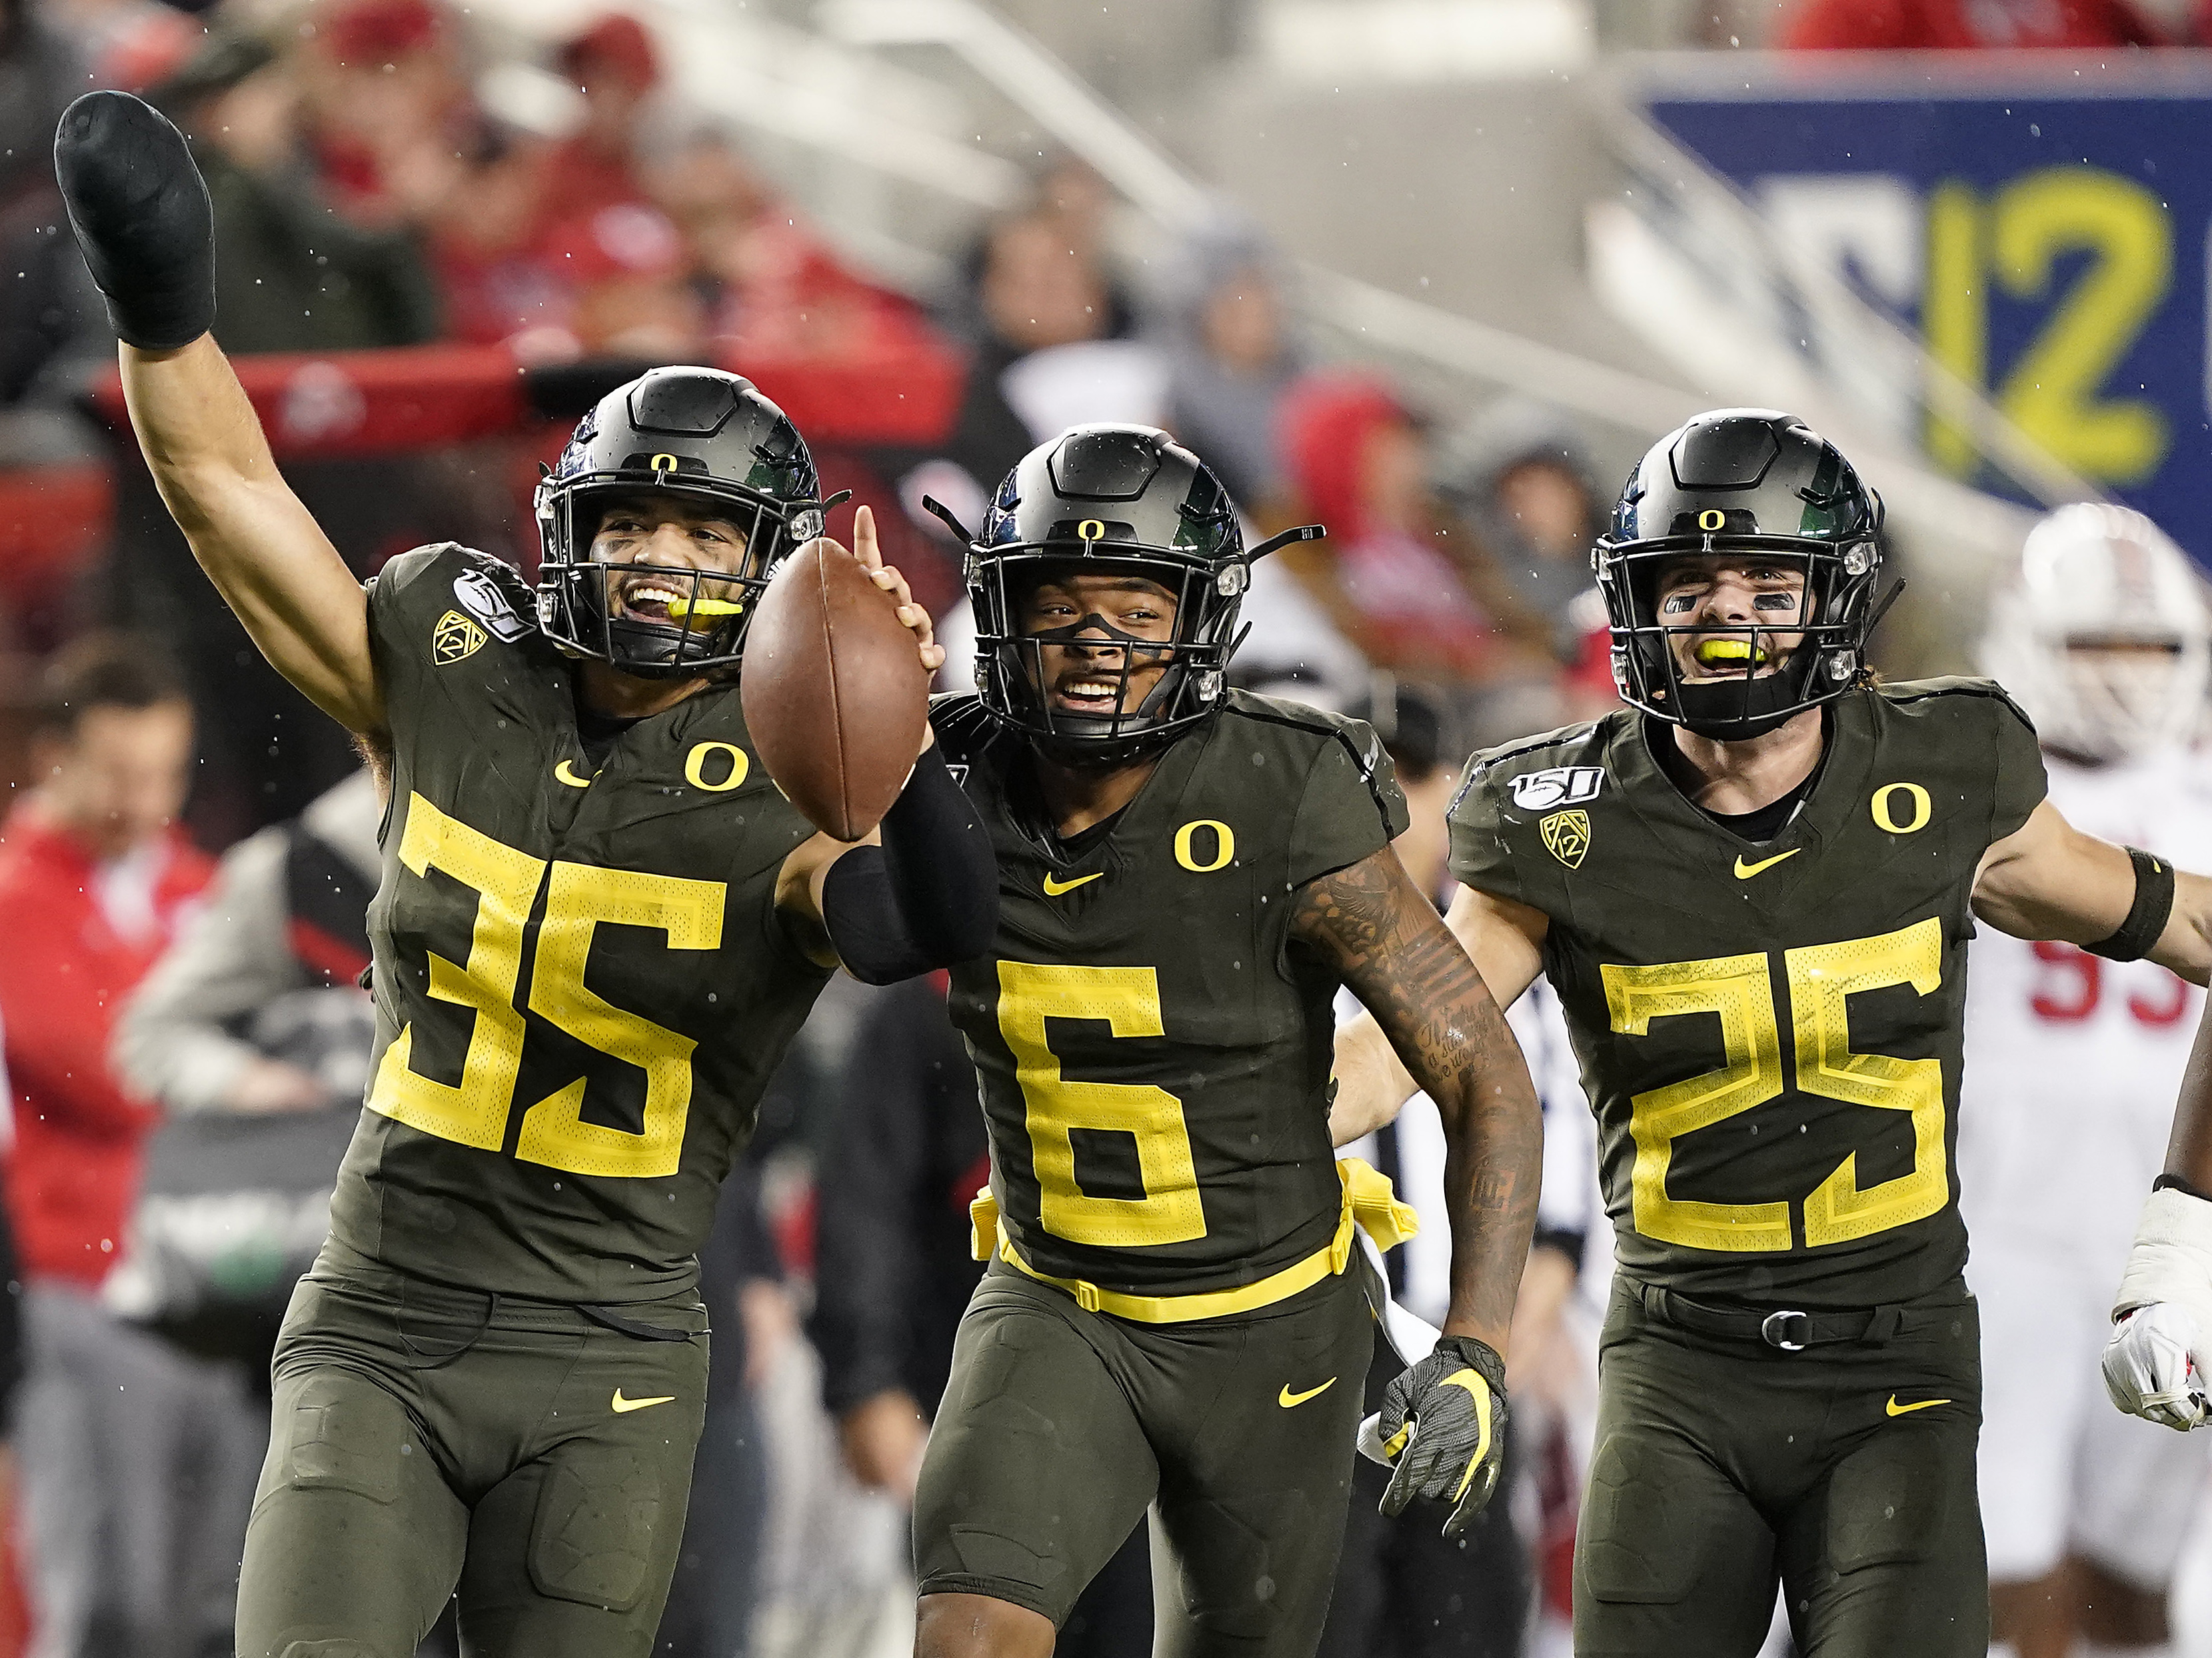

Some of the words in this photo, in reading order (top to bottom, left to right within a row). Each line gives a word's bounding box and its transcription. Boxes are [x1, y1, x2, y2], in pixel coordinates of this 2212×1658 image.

[1078, 519, 1105, 541] O
[1699, 509, 1725, 531] O
[437, 611, 486, 654] PAC
[437, 633, 465, 659] 12
[684, 741, 750, 791] O
[1507, 766, 1606, 810] 150
[1871, 782, 1932, 834] O
[1174, 819, 1236, 872] O
[1543, 812, 1588, 850] PAC
[1557, 834, 1583, 859] 12
[367, 790, 728, 1178] 35
[996, 959, 1208, 1247] 6
[1600, 915, 1949, 1252] 25
